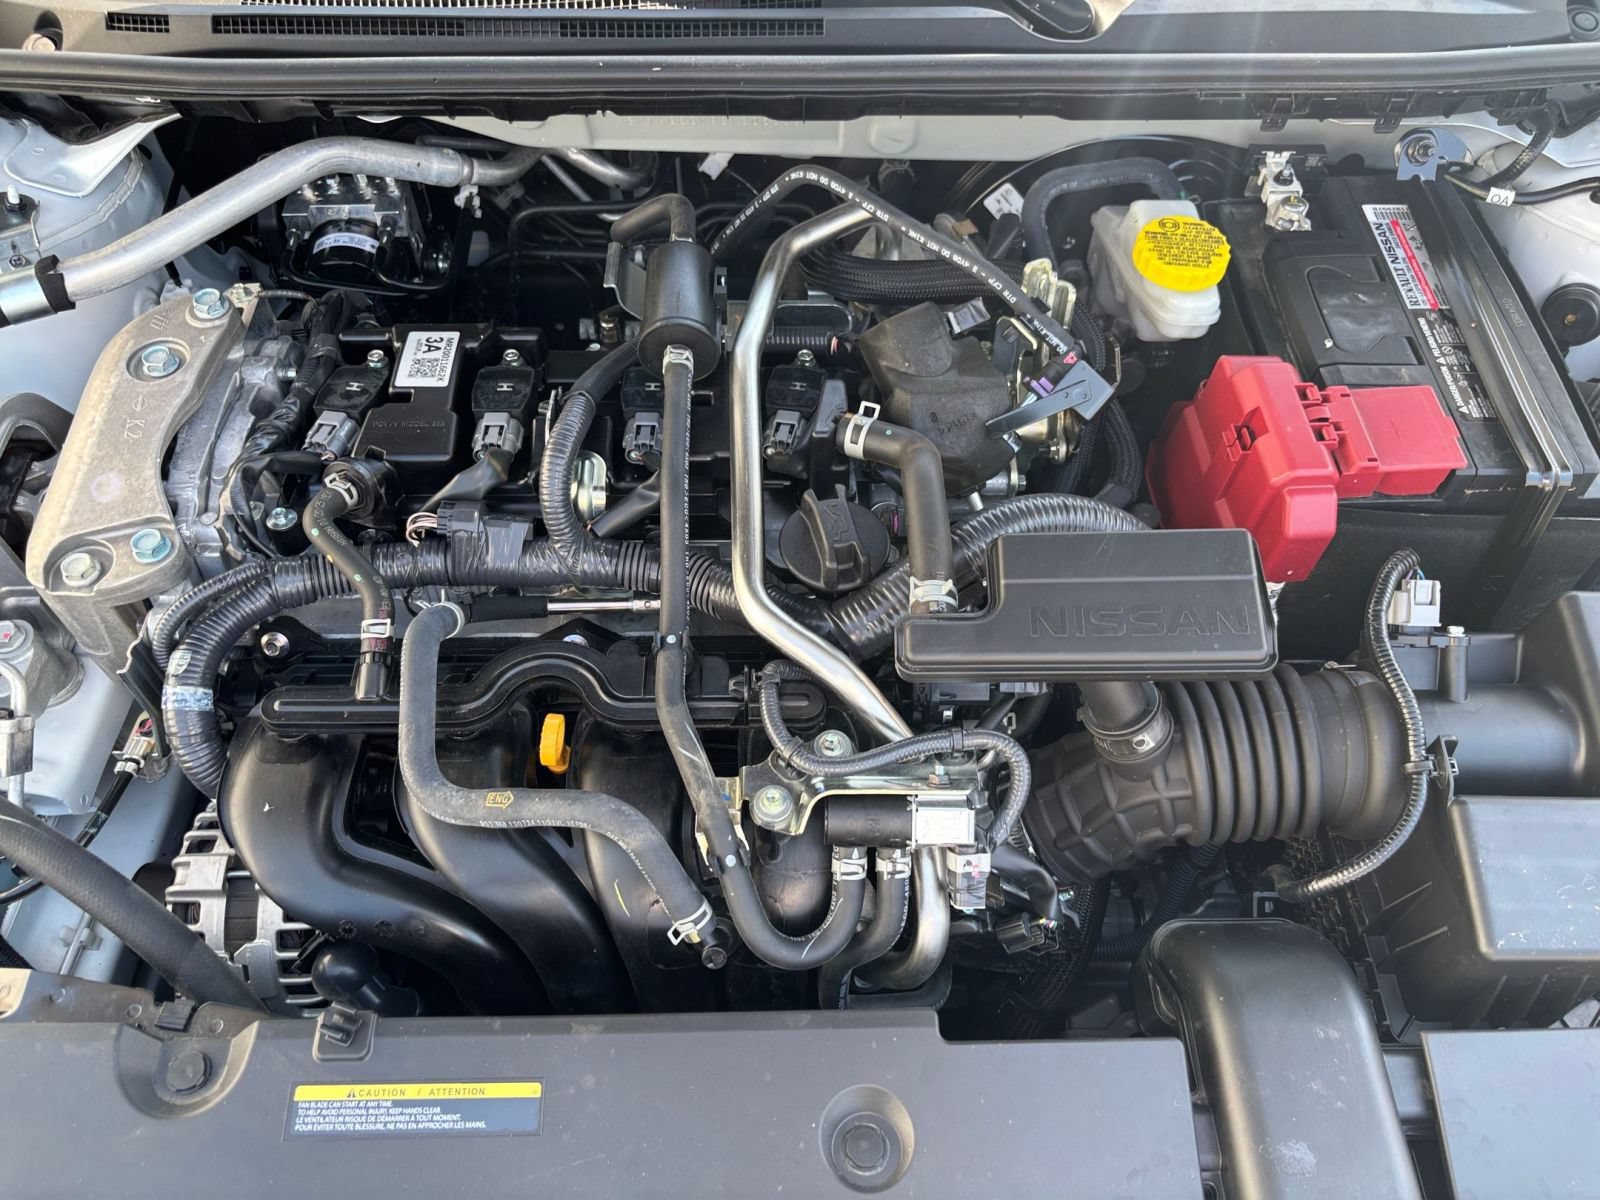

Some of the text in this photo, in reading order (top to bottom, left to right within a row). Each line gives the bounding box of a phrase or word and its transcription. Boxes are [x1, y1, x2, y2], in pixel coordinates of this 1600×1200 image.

[1373, 222, 1401, 264] NISSAN
[1393, 267, 1420, 306] RENAULT
[422, 336, 444, 354] 3A
[1028, 604, 1251, 637] NISSAN
[488, 793, 509, 804] ENG
[358, 1089, 406, 1097] CAUTION
[429, 1087, 486, 1096] ATTENTION
[341, 1100, 358, 1108] START
[423, 1106, 441, 1114] CLEAR.
[334, 1123, 353, 1131] TOUTE
[386, 1122, 395, 1130] NE
[396, 1122, 408, 1130] PAS
[417, 1121, 453, 1129] APPROCHER
[454, 1121, 465, 1129] LES
[465, 1120, 487, 1129] MAINS.
